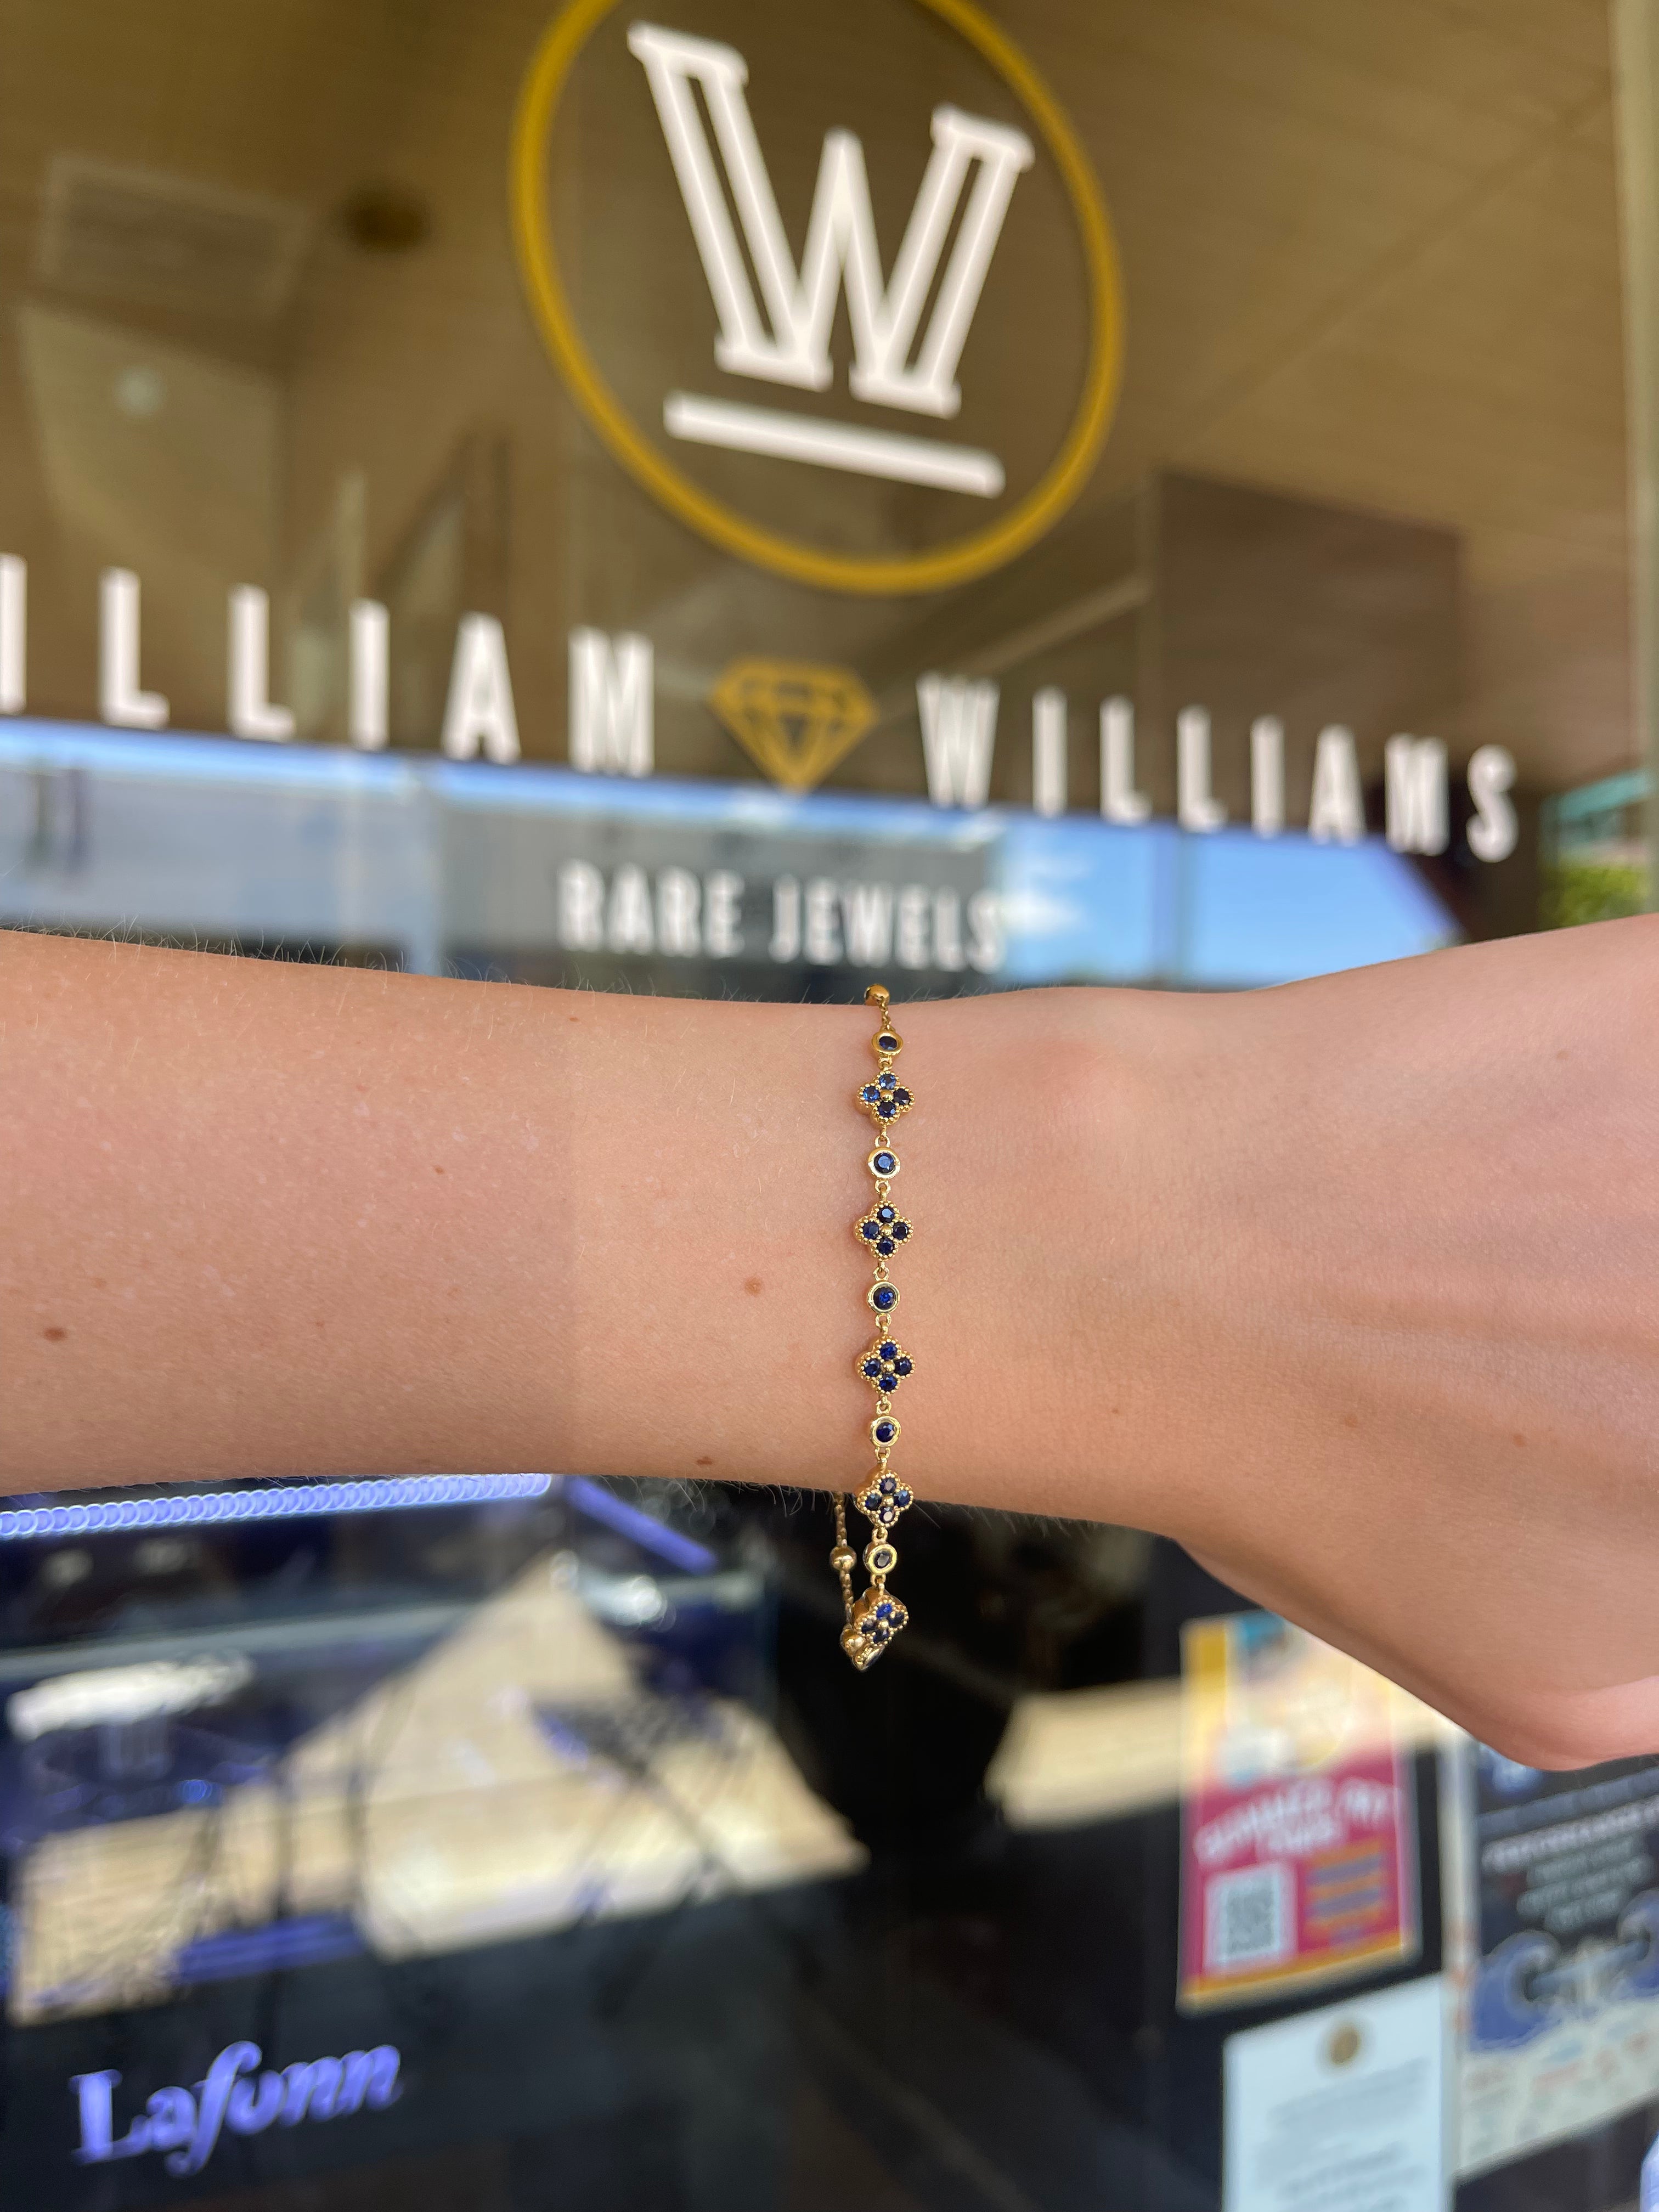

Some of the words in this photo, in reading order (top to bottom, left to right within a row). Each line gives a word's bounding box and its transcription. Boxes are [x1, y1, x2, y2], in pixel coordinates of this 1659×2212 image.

[627, 19, 1036, 420] W
[914, 669, 1520, 864] WILLIAMS
[555, 858, 747, 961] RARE
[768, 873, 1007, 975] JEWELS
